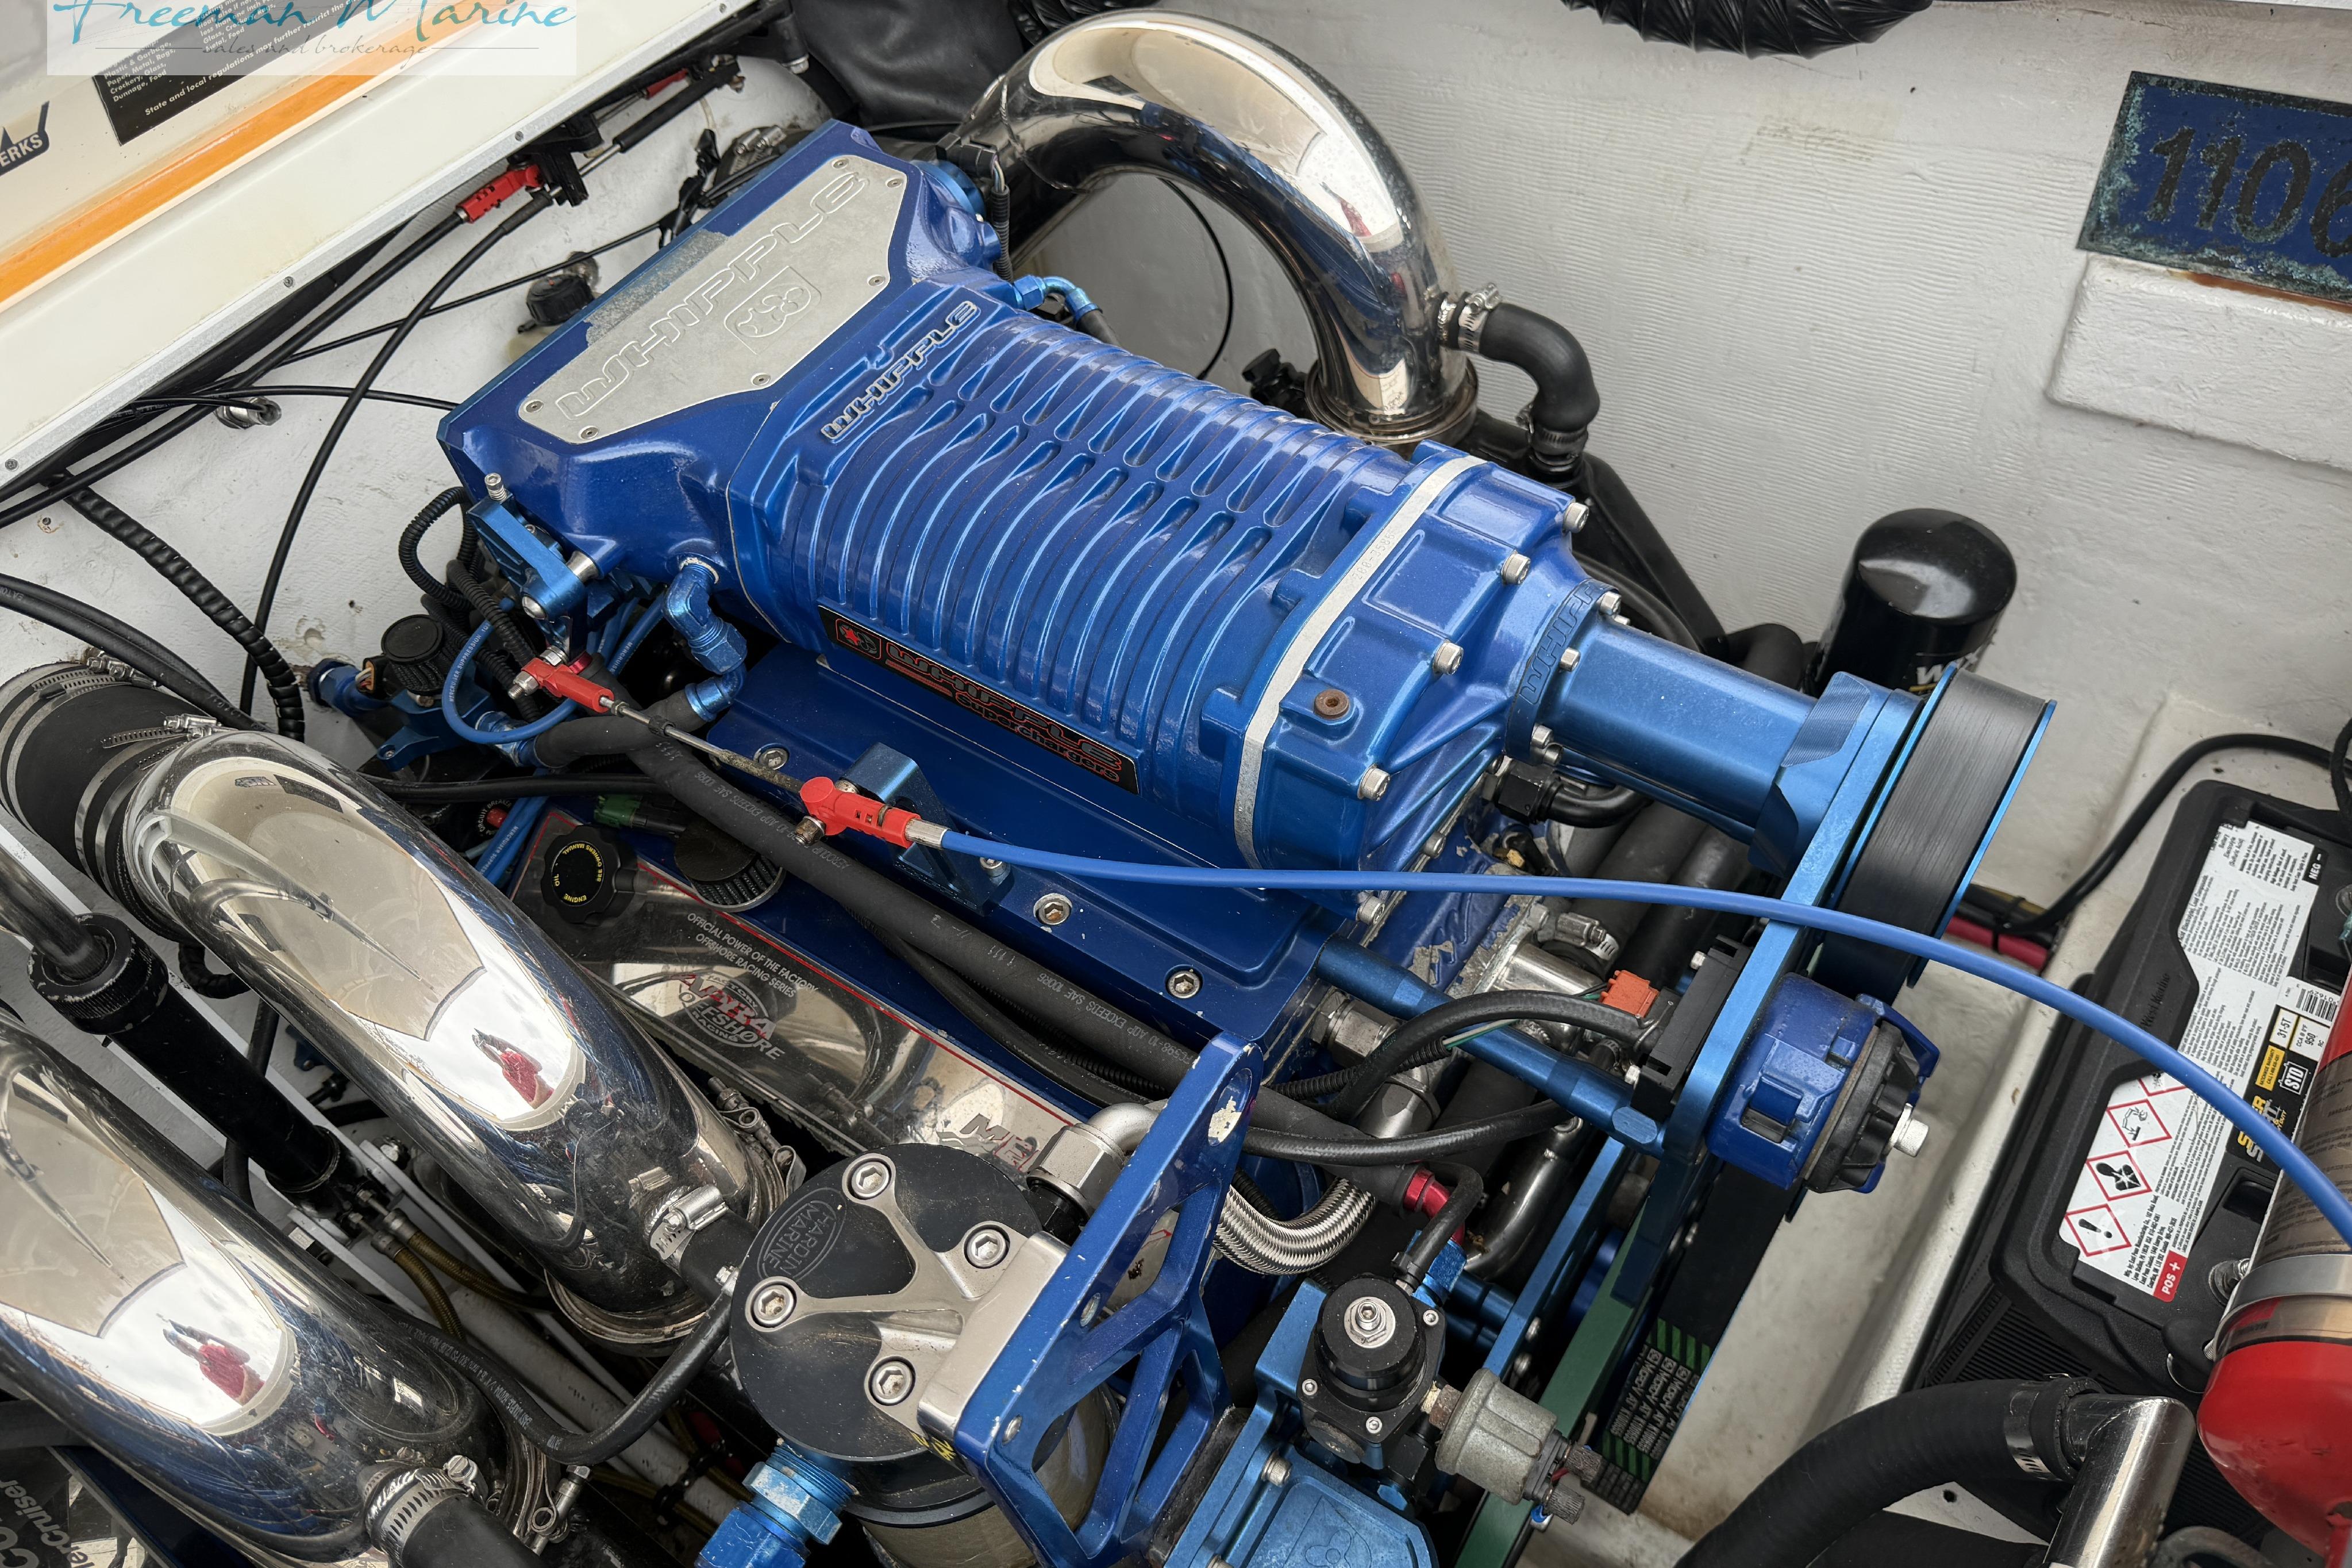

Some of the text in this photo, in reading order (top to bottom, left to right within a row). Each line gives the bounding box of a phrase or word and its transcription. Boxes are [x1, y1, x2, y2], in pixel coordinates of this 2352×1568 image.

[199, 25, 215, 37] less
[214, 16, 232, 29] than
[202, 28, 226, 45] Glass,
[226, 26, 245, 40] Food
[103, 62, 128, 80] Plastic
[136, 38, 172, 63] Garbage,
[106, 70, 132, 88] Paper,
[130, 57, 155, 74] Metal,
[155, 46, 176, 61] Rags,
[144, 99, 168, 115] State
[167, 88, 186, 102] and
[186, 76, 207, 92] local
[207, 50, 256, 82] regulations
[255, 41, 275, 56] may
[272, 24, 304, 45] further
[109, 60, 167, 96] Crockery, Glass,
[112, 68, 167, 103] Dunnage, Food
[0, 134, 43, 167] ERKS
[554, 172, 870, 421] WHIPPLE
[821, 300, 981, 440] WHIPPLE
[459, 633, 482, 669] SUPPRESSION
[886, 642, 1122, 770] WHIPPLE
[955, 691, 1120, 783] Superchargers
[562, 843, 584, 854] MANUAL
[586, 845, 602, 866] OWNERS
[2308, 862, 2322, 880] NEG
[563, 893, 587, 902] ENGINE
[686, 911, 723, 939] OFFICIAL
[721, 932, 753, 957] POWER
[749, 950, 765, 964] OF
[763, 957, 780, 973] THE
[694, 931, 797, 999] OFFSHORE RACING SERIES
[1036, 970, 1065, 993] 100R6
[1064, 987, 1086, 1005] SAE
[1084, 999, 1128, 1030] EXCEEDS
[2276, 1016, 2292, 1039] 31-5T
[2295, 1035, 2304, 1047] CCA
[2303, 1031, 2317, 1046] 950
[2317, 1039, 2325, 1047] RC
[2282, 1065, 2305, 1091] STD
[763, 1201, 821, 1269] MARINE
[779, 1211, 837, 1275] HARDIN
[2161, 1272, 2177, 1295] POS
